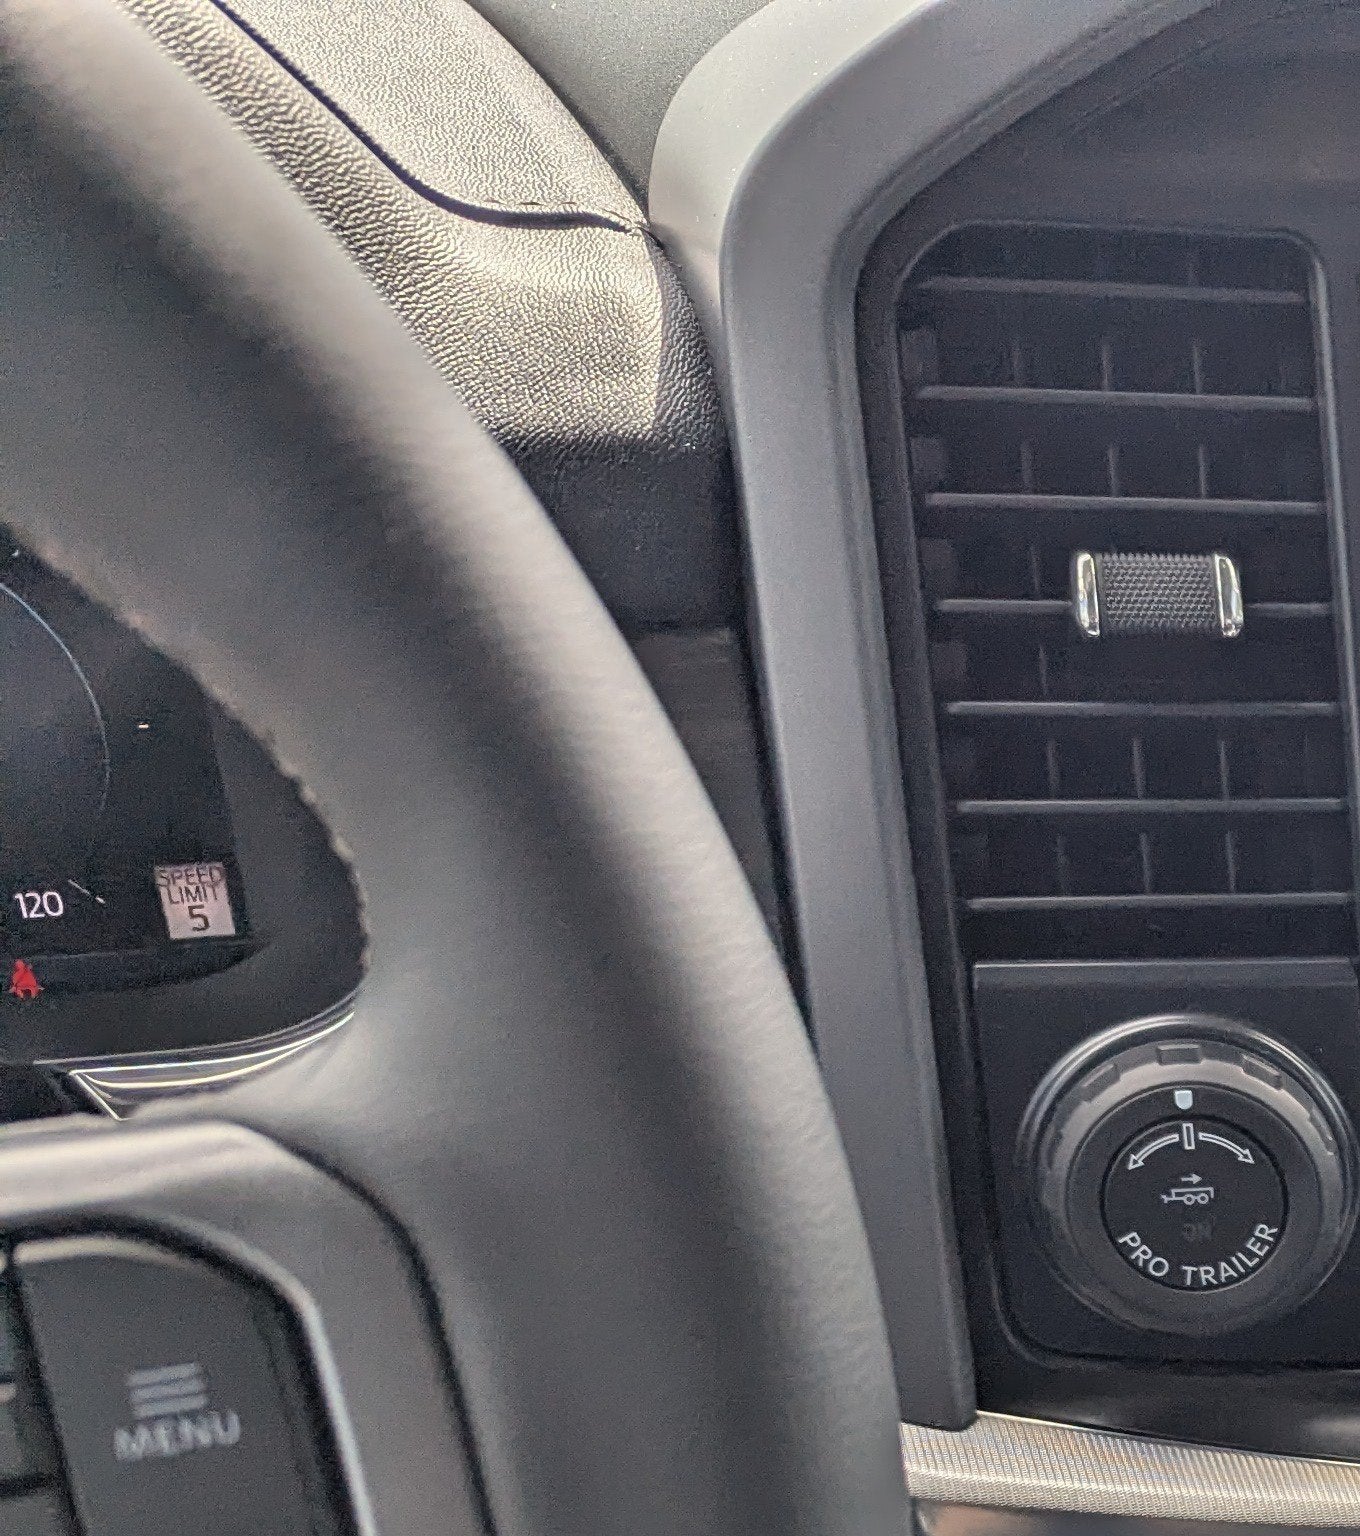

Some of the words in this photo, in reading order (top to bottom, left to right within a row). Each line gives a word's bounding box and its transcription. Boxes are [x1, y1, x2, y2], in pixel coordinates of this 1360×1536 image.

[156, 866, 227, 888] SPEED
[14, 890, 65, 919] 120
[166, 884, 221, 905] LIMIT
[187, 903, 211, 932] 5
[1118, 1231, 1170, 1277] PRO
[1182, 1223, 1279, 1287] TRAILER
[114, 1409, 242, 1462] MENU
